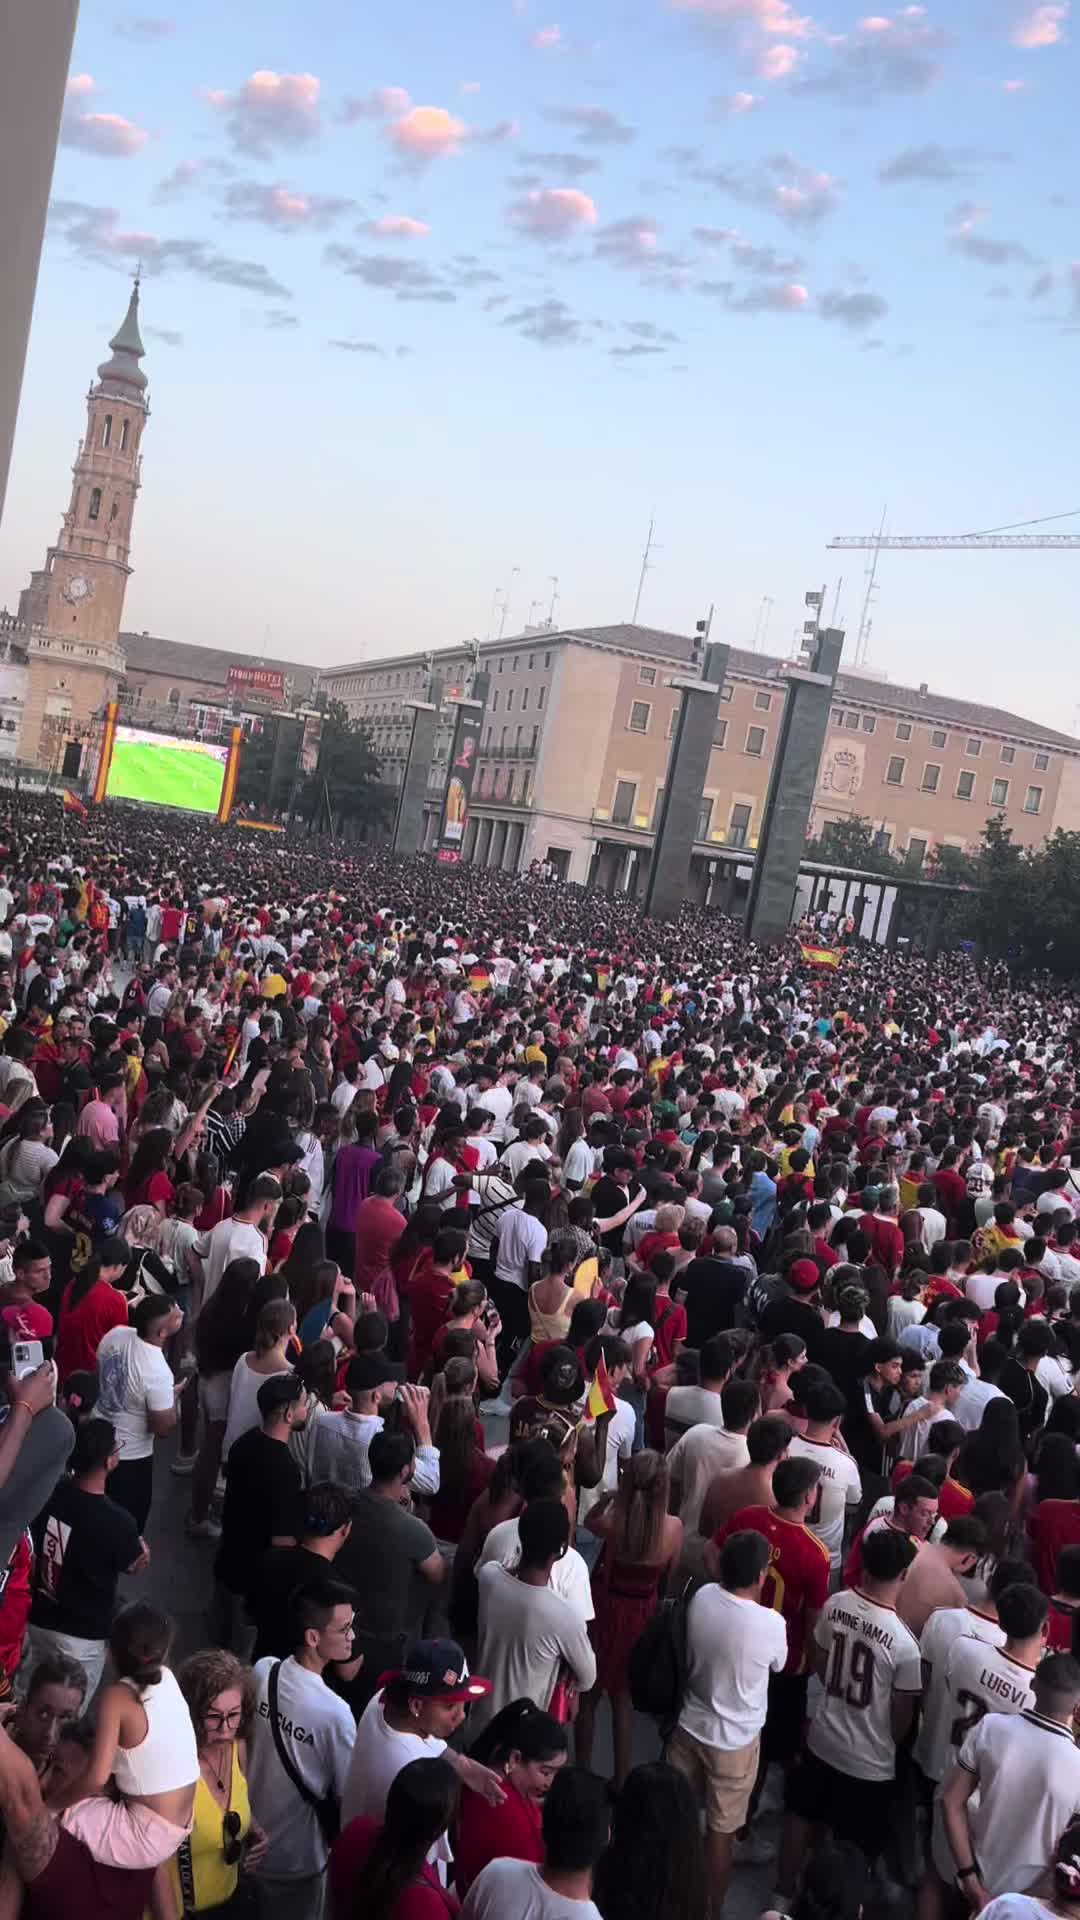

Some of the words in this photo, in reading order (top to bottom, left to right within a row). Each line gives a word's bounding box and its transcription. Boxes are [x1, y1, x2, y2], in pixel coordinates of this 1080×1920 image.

[254, 672, 281, 683] HOTEL
[863, 1621, 893, 1650] YAMAL
[826, 1630, 875, 1709] 19
